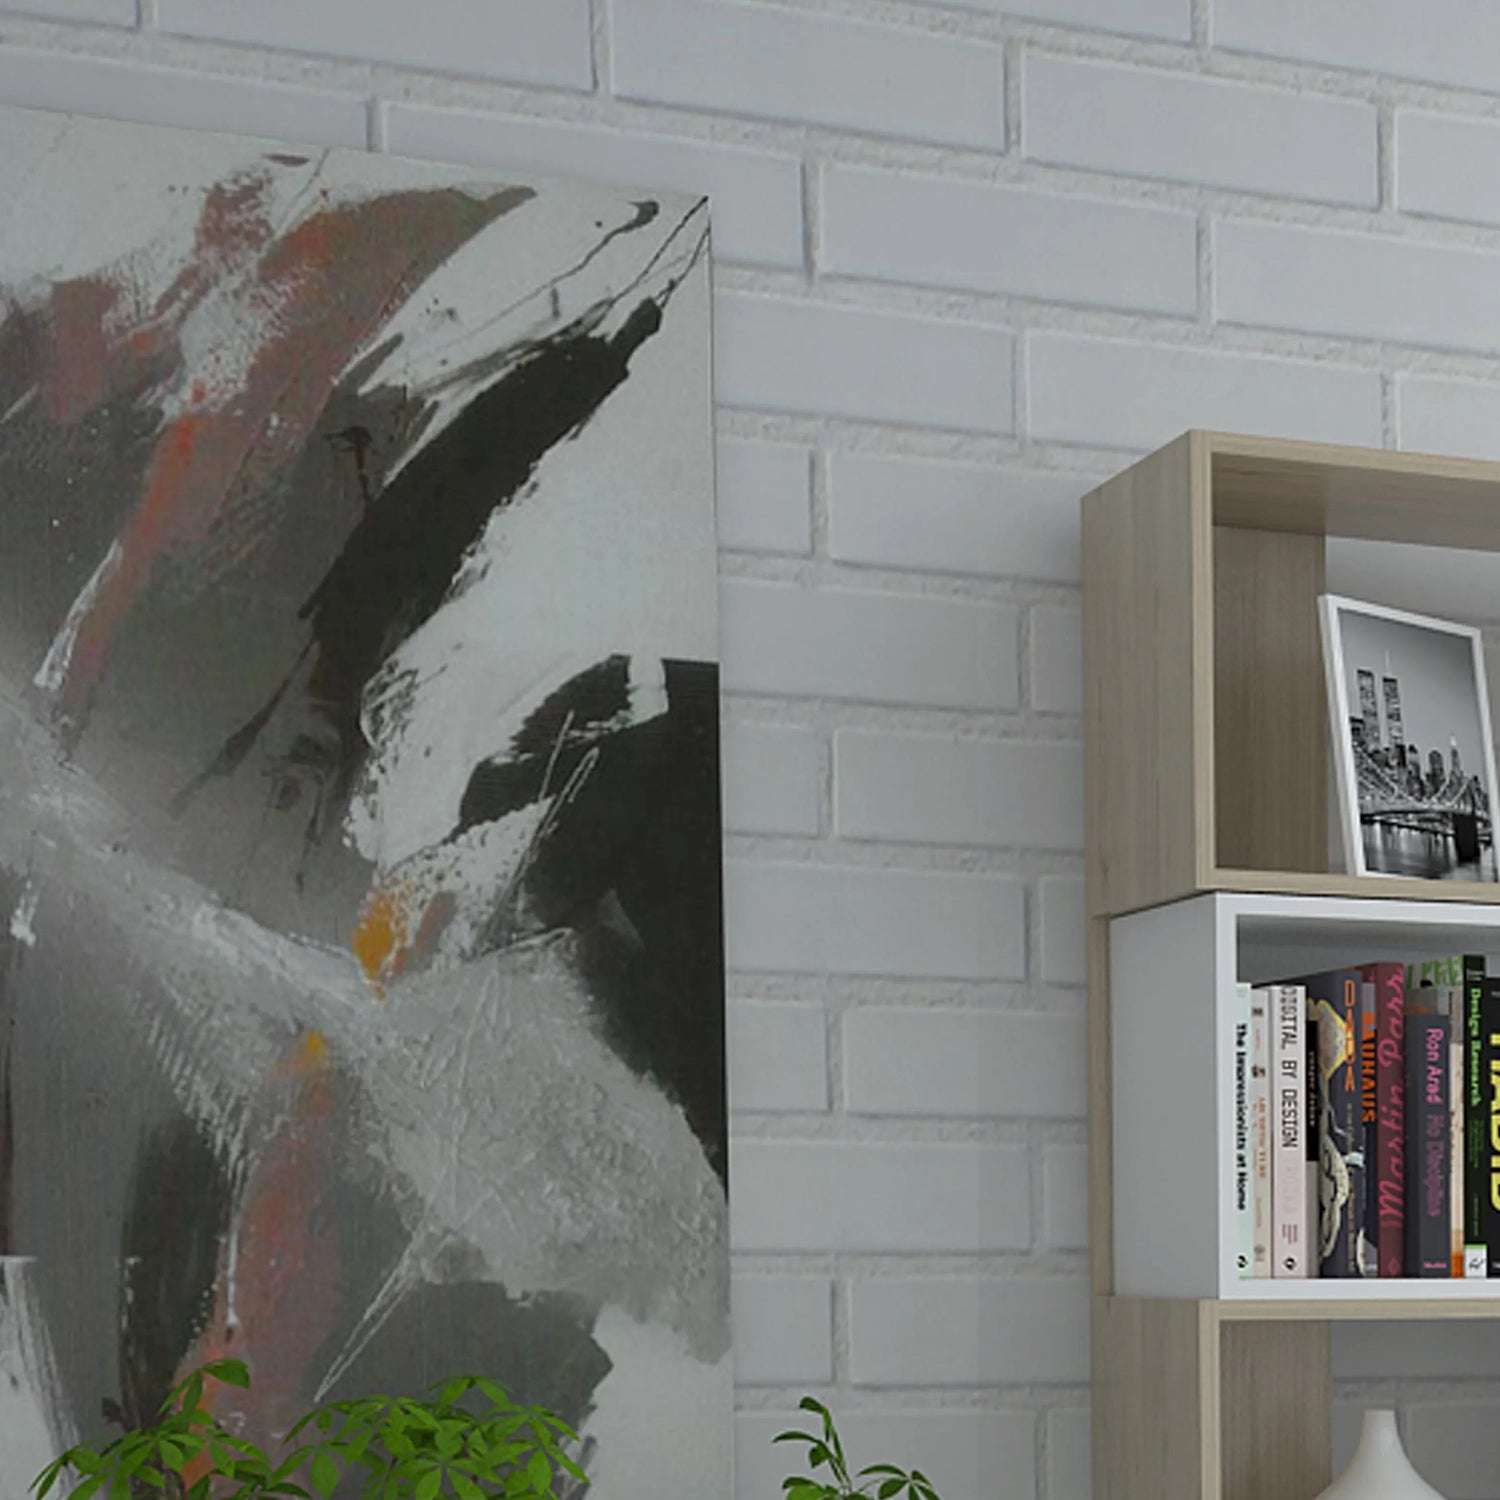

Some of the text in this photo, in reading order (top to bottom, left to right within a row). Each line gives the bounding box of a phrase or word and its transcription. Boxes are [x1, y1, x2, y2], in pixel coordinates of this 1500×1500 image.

[1281, 986, 1298, 1050] DIGITAL
[1468, 988, 1482, 1037] Design
[1236, 1024, 1247, 1048] The
[1426, 1028, 1443, 1061] Ron
[1281, 1060, 1297, 1079] BY
[1426, 1066, 1443, 1105] Arad
[1281, 1089, 1298, 1148] DESIGN
[1236, 1154, 1246, 1168] at
